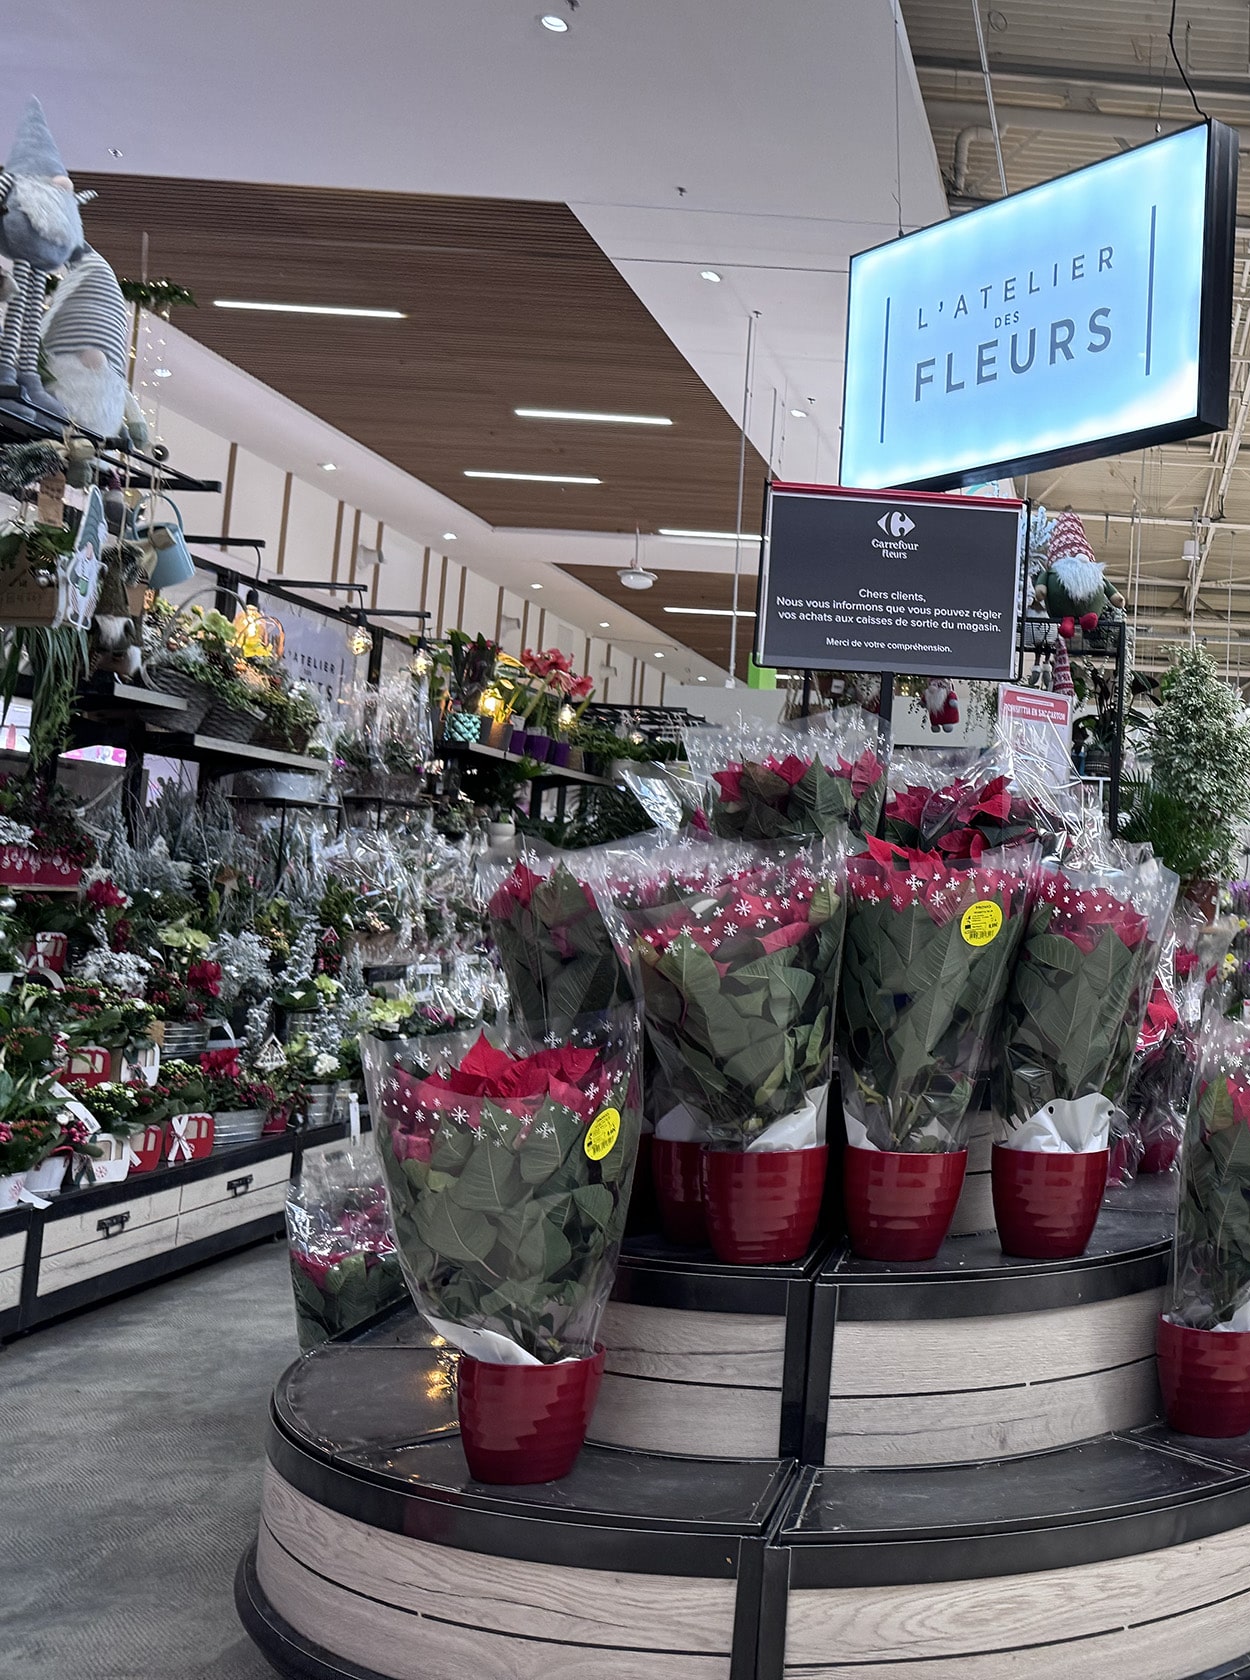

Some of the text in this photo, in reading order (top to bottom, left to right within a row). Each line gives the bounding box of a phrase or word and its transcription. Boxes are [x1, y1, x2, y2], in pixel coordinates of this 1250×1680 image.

[918, 246, 1114, 330] L'ATELIER
[994, 310, 1020, 329] DES
[915, 307, 1112, 403] FLEURS
[871, 538, 919, 551] Carrefour
[882, 549, 908, 560] fleurs
[858, 588, 926, 603] Chers clients,
[776, 596, 1002, 621] Nous vous informons que vous pouvez régler
[778, 611, 1002, 633] vos achats aux caisses de sortie du magasin.
[826, 637, 953, 653] Merci de votre compréhension.
